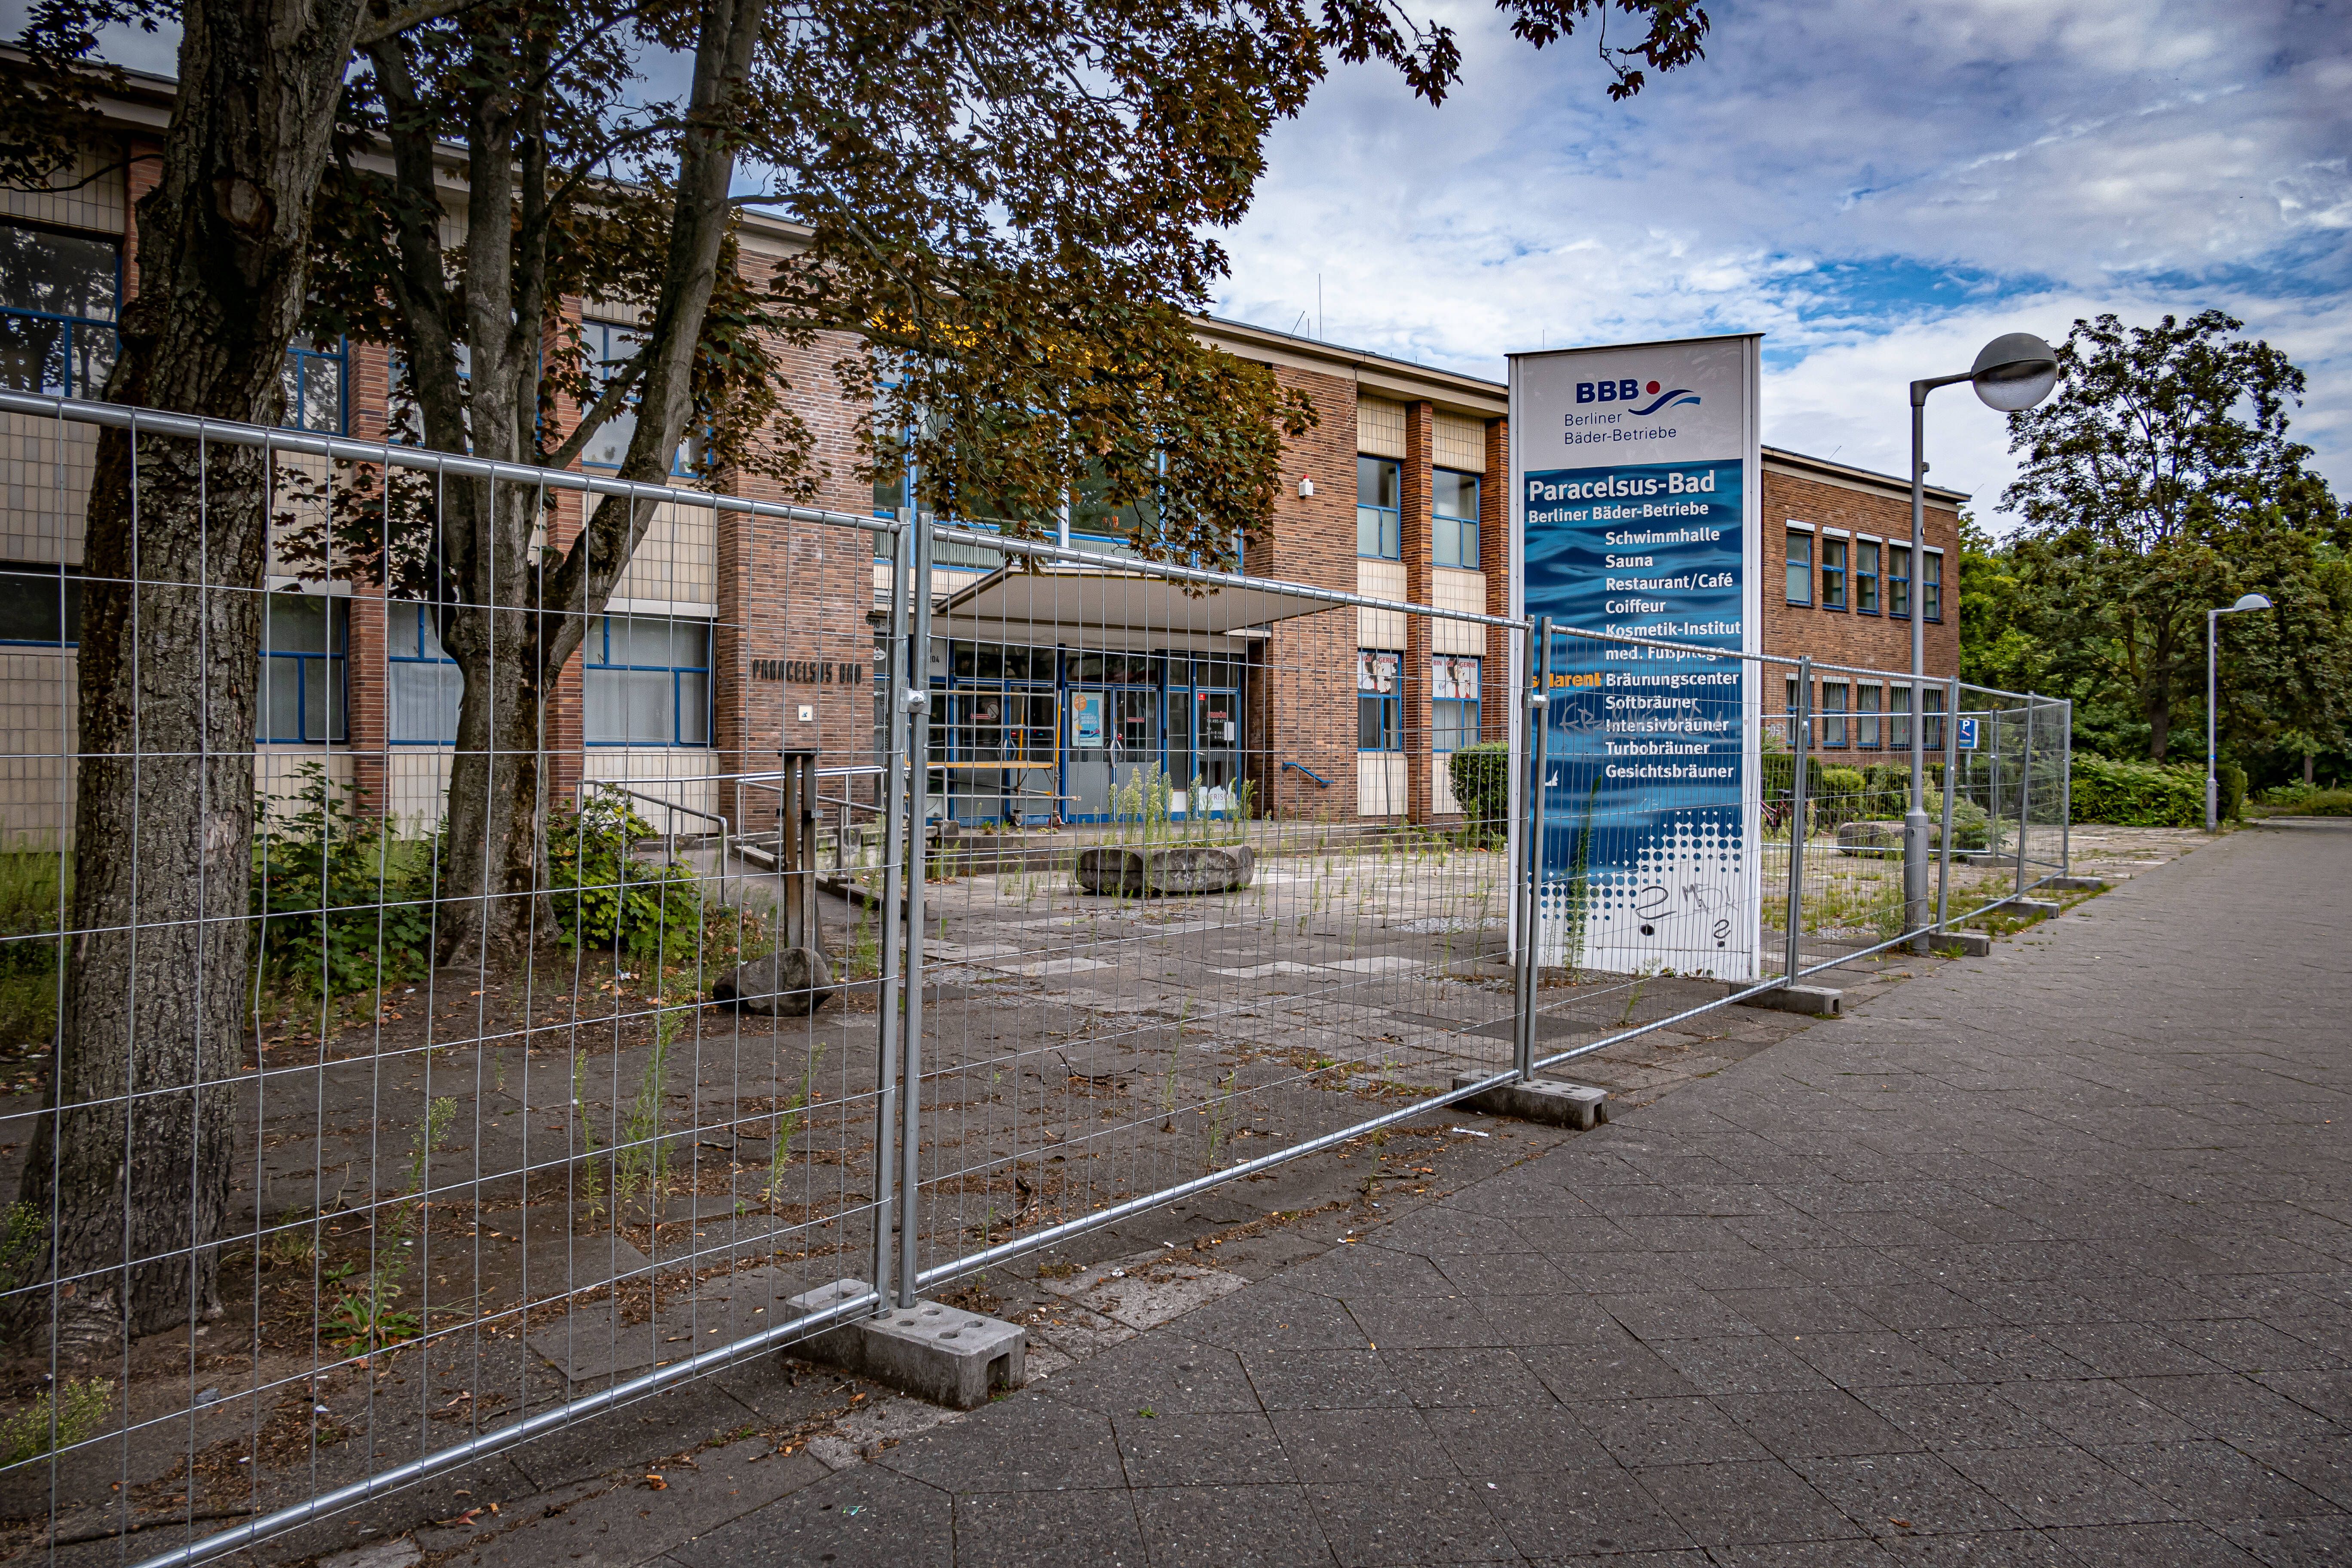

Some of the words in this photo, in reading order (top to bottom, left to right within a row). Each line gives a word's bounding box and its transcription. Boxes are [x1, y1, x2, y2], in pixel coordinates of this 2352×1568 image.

[1576, 379, 1640, 404] BBB
[1565, 412, 1622, 426] Berliner
[1565, 426, 1677, 444] Bäder-Betriebe
[1529, 469, 1715, 501] Paracelsus-Bad
[1528, 508, 1588, 523] Berliner
[1593, 501, 1709, 520] Bäder-Betriebe
[1605, 527, 1720, 545] Schwimmhalle
[1605, 555, 1653, 568] Sauna
[1606, 573, 1733, 591] Restaurant/Café
[1605, 599, 1666, 614] Coiffeur
[1606, 621, 1741, 637] Kosmetik-Institut
[1606, 646, 1643, 660] med.
[753, 659, 833, 683] PARACELSUS
[840, 663, 862, 684] BAD
[1531, 672, 1602, 688] slarent
[1606, 671, 1740, 689] Bräunungscenter
[1605, 695, 1698, 710] Softbräuner
[1606, 718, 1729, 732] Intensivbräuner
[1963, 720, 1970, 730] P
[1605, 741, 1710, 756] Turbobräuner
[1606, 764, 1734, 778] Gesichtsbräuner
